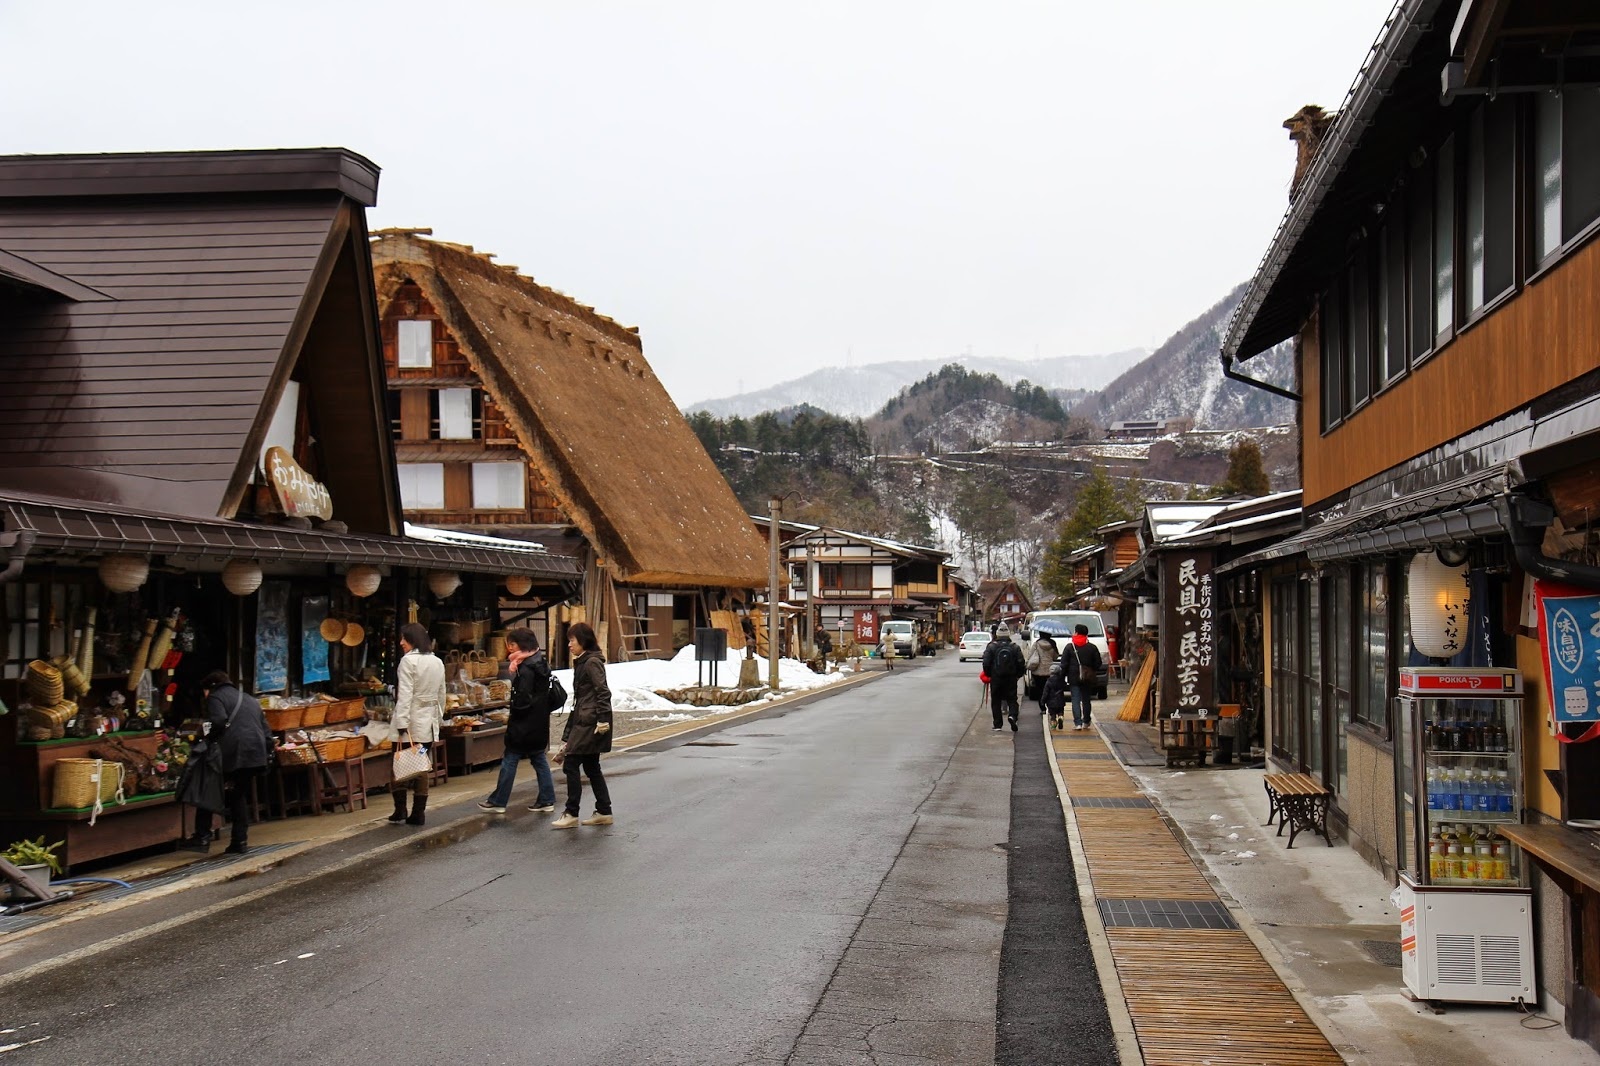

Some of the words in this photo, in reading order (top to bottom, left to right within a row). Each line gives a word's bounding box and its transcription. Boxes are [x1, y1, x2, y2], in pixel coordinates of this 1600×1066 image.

[862, 612, 873, 638] 地酒
[1175, 559, 1201, 706] 民具・民芸品
[1200, 573, 1212, 667] 手作りのおみやげ
[1556, 617, 1578, 663] 味自慢
[1438, 676, 1467, 684] POKKA
